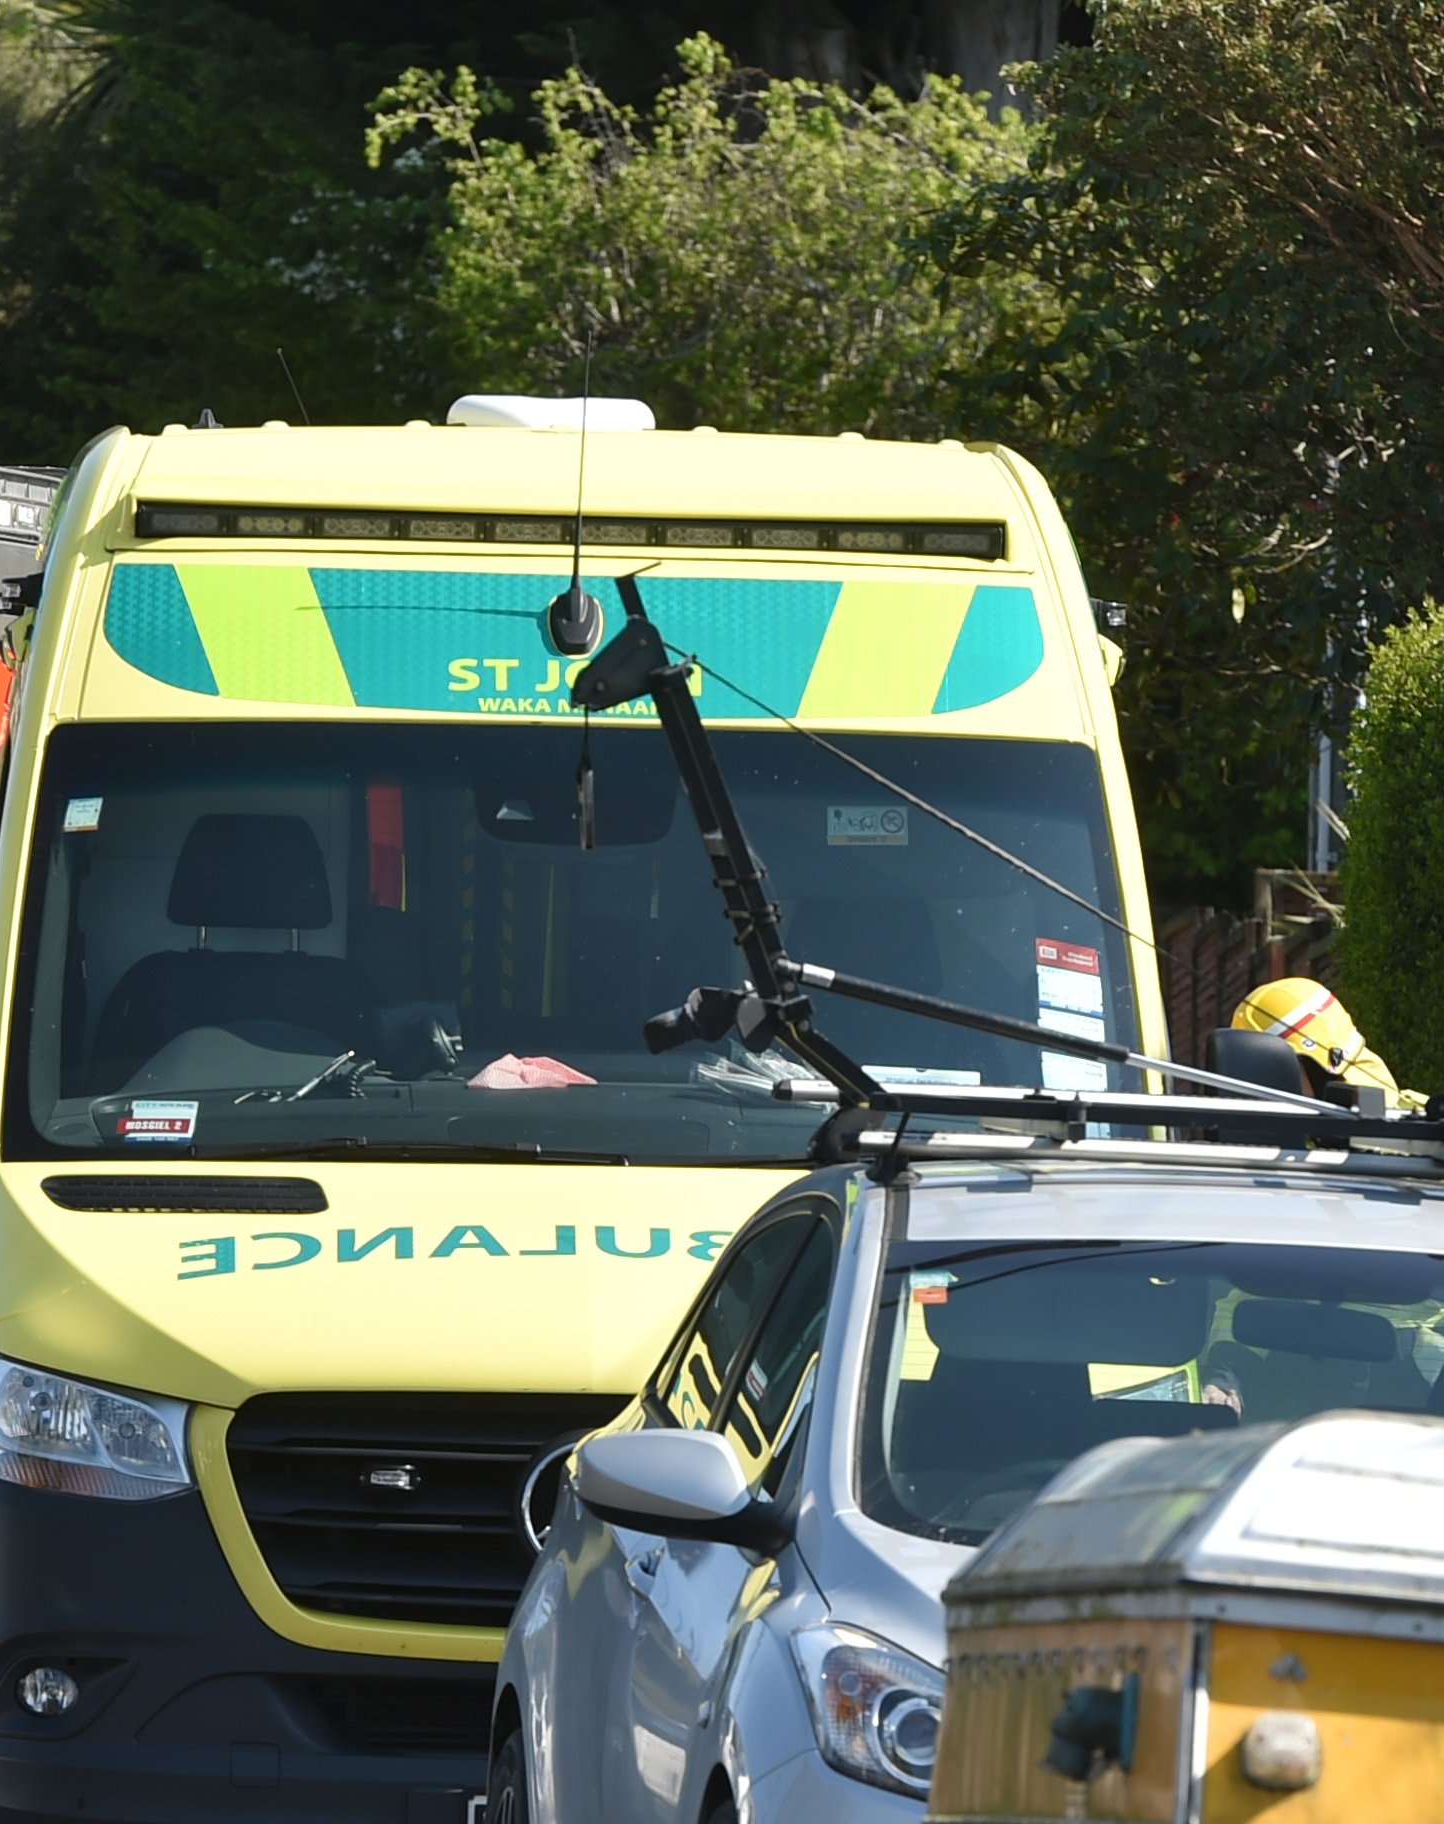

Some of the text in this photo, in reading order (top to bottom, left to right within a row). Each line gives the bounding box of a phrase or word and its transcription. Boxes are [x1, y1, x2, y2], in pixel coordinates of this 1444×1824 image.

[447, 658, 520, 692] ST
[477, 697, 552, 713] WAKA
[124, 1120, 171, 1131] MOSGIEL
